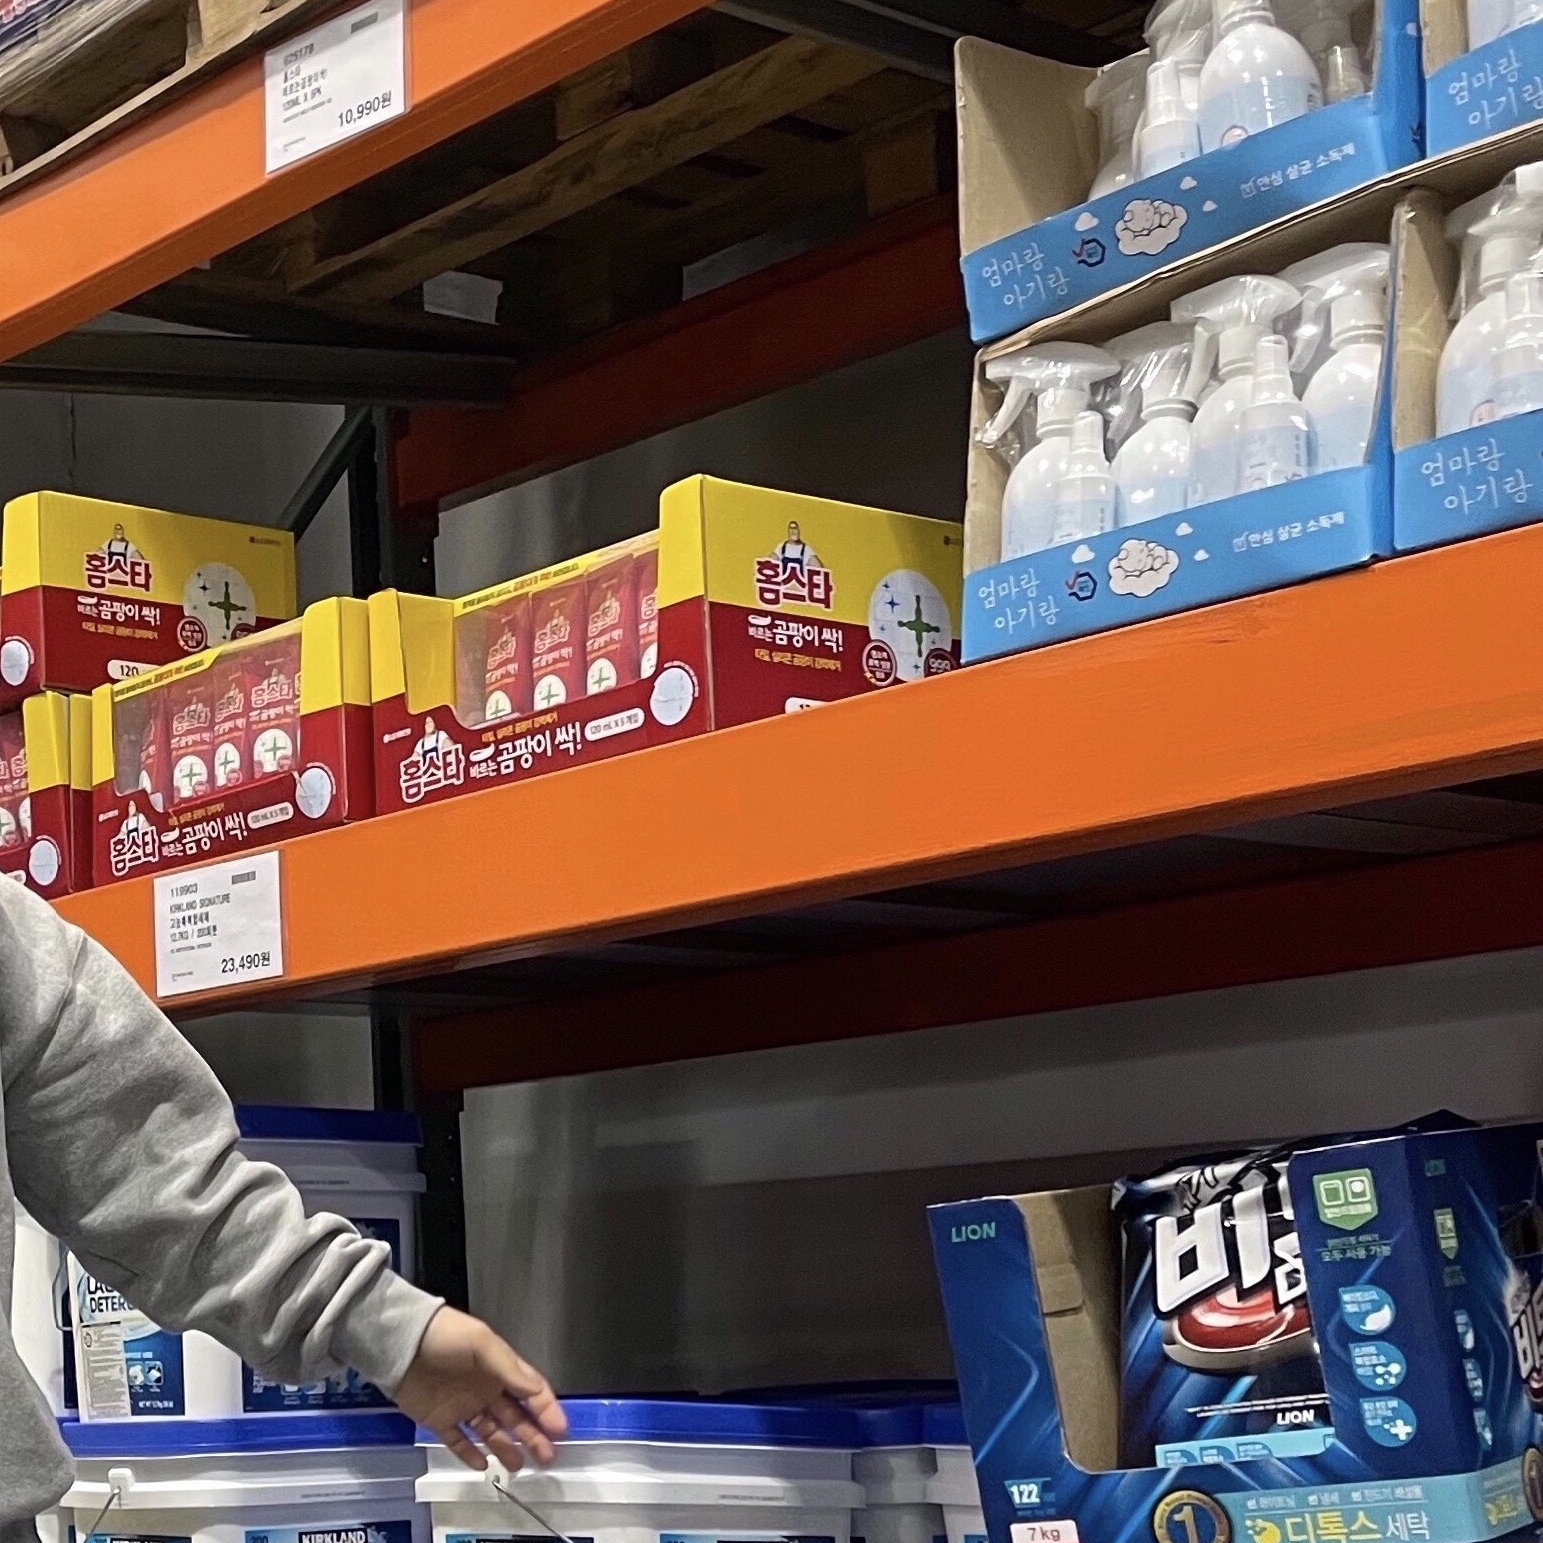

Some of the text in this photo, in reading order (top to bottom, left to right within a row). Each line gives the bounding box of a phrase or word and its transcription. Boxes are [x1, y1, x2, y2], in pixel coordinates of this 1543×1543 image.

[1448, 49, 1523, 106] 엄마랑
[338, 90, 391, 126] 10,990원
[982, 243, 1045, 287] 엄마랑
[1003, 267, 1070, 310] 아기랑
[1420, 439, 1505, 488] 엄마랑
[1444, 469, 1533, 515] 아기랑
[85, 553, 152, 592] 홈스타
[756, 558, 833, 611] 홈스타
[978, 568, 1040, 609] 엄마랑
[98, 600, 139, 620] 곰팡이
[993, 600, 1060, 634] 아기랑
[773, 620, 843, 653] 곰팡이 싹!
[497, 730, 552, 774] 곰팡이
[555, 722, 582, 756] 싹!
[400, 744, 465, 803] 홈스타
[110, 826, 159, 876] 홈스타
[182, 818, 224, 855] 곰팡이
[221, 951, 270, 975] 23,490원
[951, 1221, 997, 1242] LION
[1277, 1409, 1314, 1425] LION
[1010, 1484, 1039, 1505] 122
[1386, 1511, 1430, 1541] 세탁
